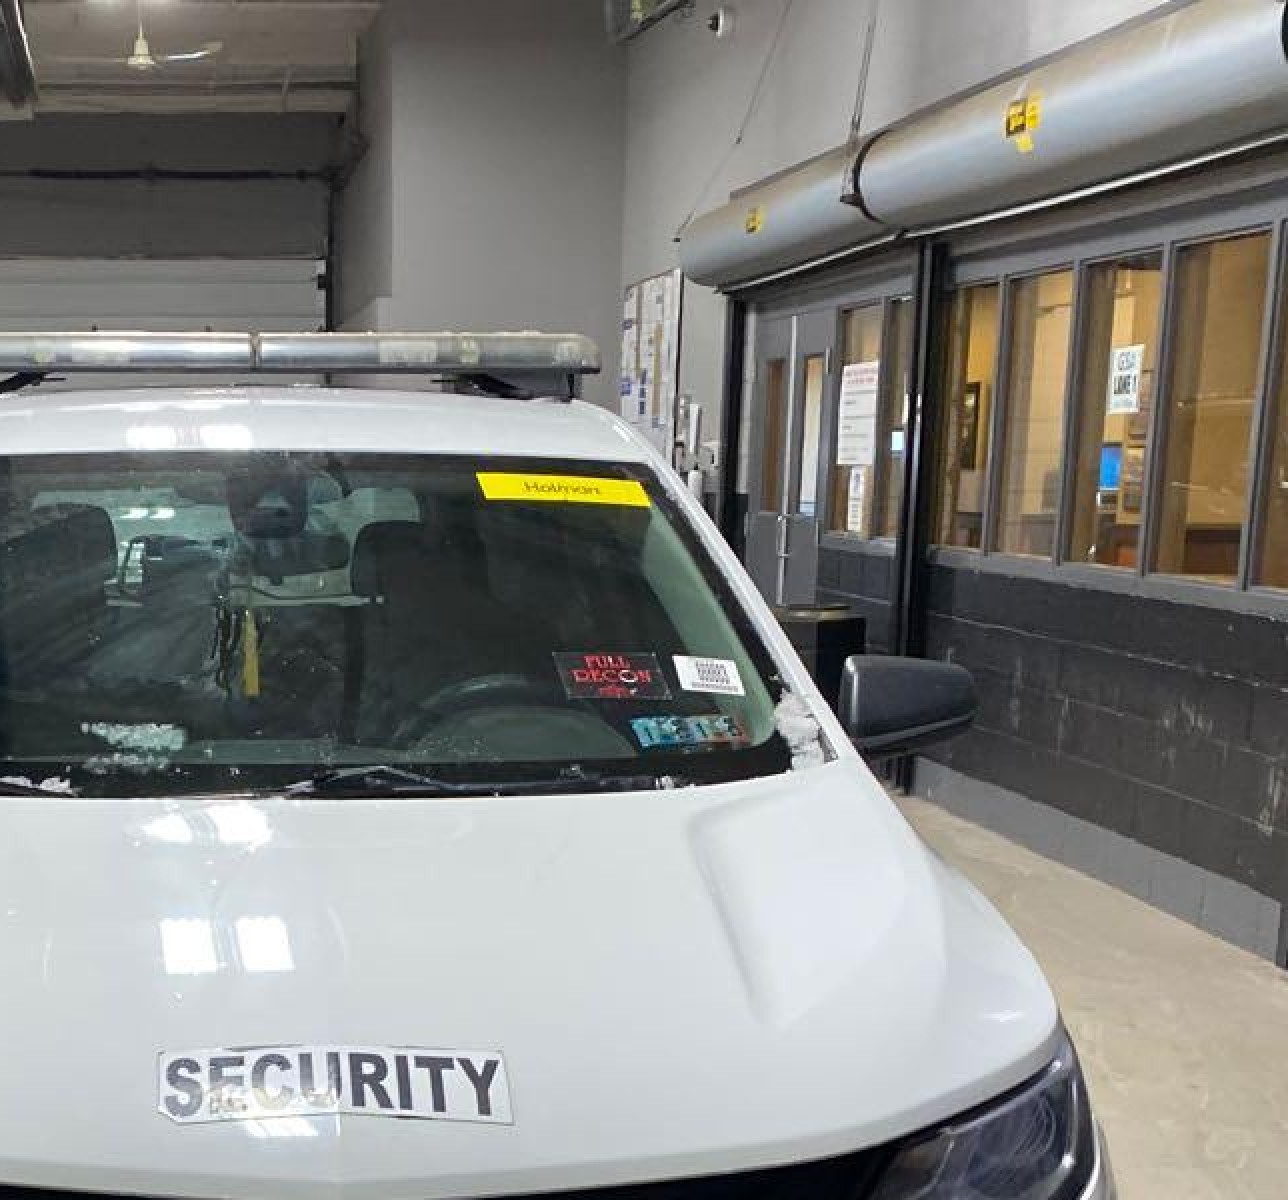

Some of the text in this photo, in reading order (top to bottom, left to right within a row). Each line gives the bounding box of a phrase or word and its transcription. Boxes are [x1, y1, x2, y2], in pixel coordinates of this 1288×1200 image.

[584, 655, 631, 668] FULL
[571, 669, 652, 682] DECON
[163, 1051, 500, 1117] SECURITY
